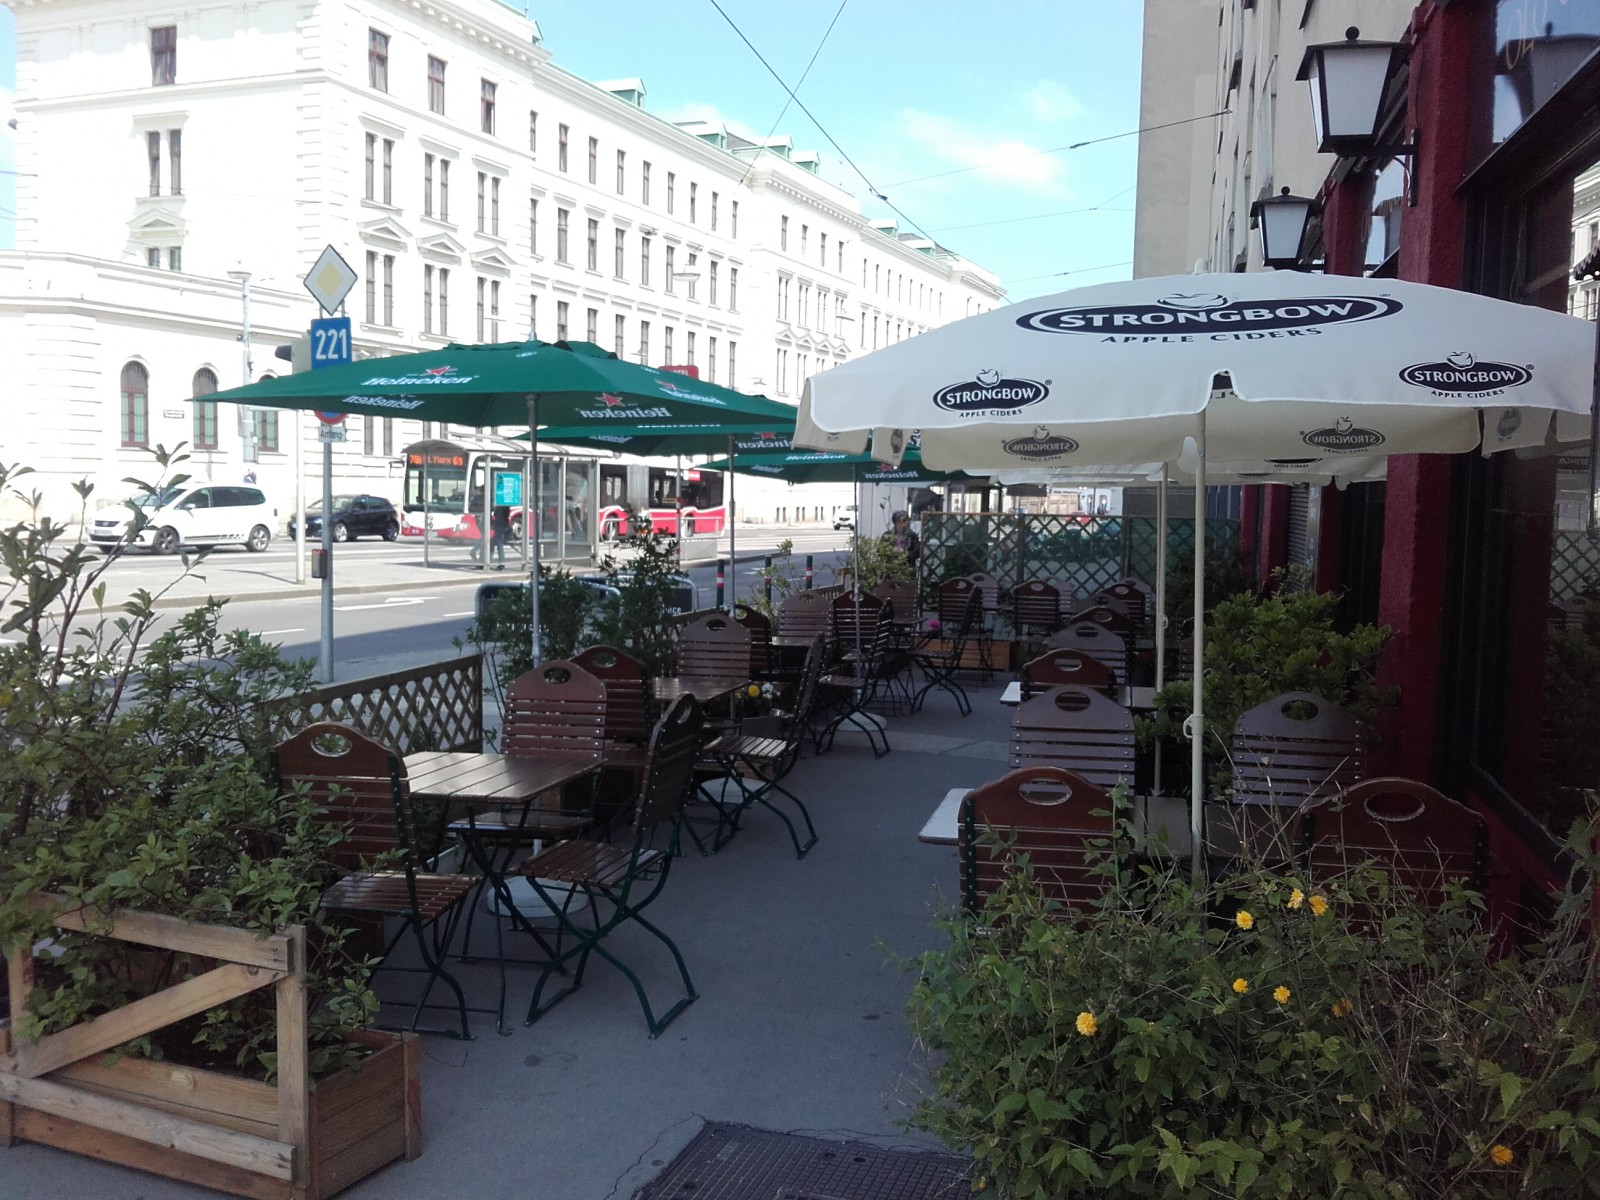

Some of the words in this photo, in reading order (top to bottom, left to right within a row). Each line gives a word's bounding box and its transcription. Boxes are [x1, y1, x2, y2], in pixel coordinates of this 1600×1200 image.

[1059, 302, 1354, 327] STRONGBOW
[1100, 335, 1194, 343] APPLE
[1210, 327, 1322, 342] CIDERS
[315, 328, 348, 360] 221
[360, 375, 473, 386] Heineken
[1414, 370, 1517, 383] STRONGBOW
[946, 387, 1036, 405] STRONGBOW
[1430, 389, 1463, 398] APPLE
[1467, 389, 1505, 399] CIDERS
[959, 410, 986, 418] APPLE
[990, 409, 1022, 417] CIDERS
